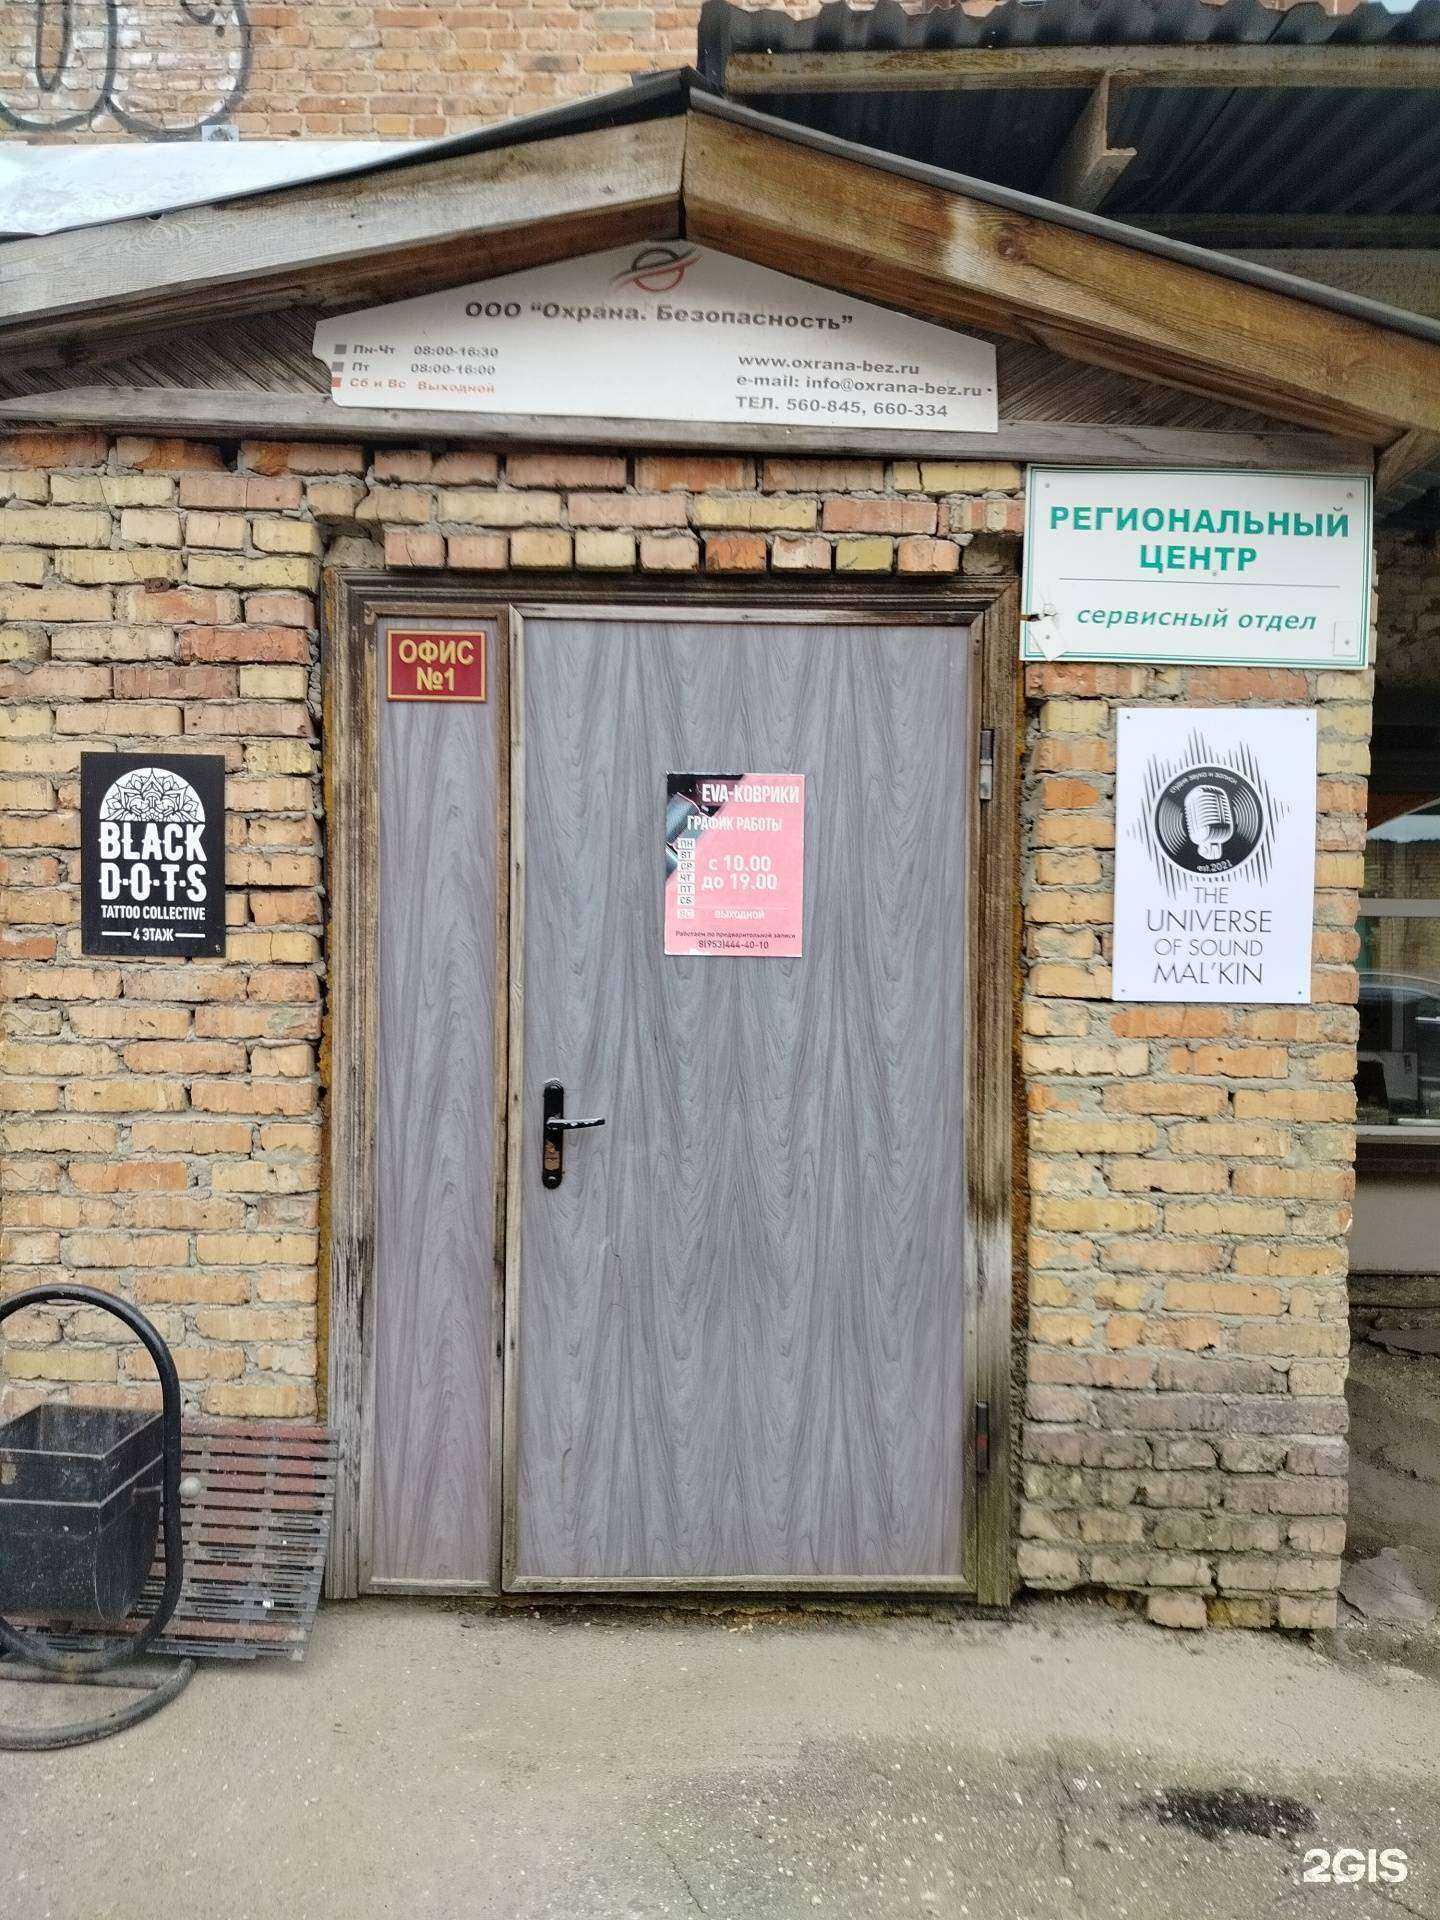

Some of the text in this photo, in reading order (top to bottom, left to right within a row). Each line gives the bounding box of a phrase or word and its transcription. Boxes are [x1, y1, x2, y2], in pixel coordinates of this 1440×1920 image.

[465, 302, 522, 317] ООО
[353, 344, 499, 357] Пн-Чт 08:00-16:30
[352, 362, 496, 375] Пт 08:00-16:00
[738, 355, 920, 375] www.oxrana-bez.ru
[350, 377, 368, 387] Сб
[417, 380, 496, 394] Выходной
[736, 374, 983, 397] e-mail: info@oxrana-bez.ru
[736, 396, 948, 417] ТЕЛ. 560-845, 660-334
[1050, 505, 1350, 538] РЕГИОНАЛЬНЫЙ
[1140, 544, 1258, 574] ЦЕНТР
[1077, 607, 1316, 632] сервисный отдел
[399, 639, 475, 665] ОФИС
[416, 666, 455, 691] №1
[701, 783, 800, 804] EVA-КОВРИКИ
[687, 815, 782, 832] ГРАФИК РАБОТЫ
[99, 822, 207, 861] BLACK
[723, 854, 772, 872] 10.00
[729, 873, 778, 890] 19.00
[1193, 886, 1229, 904] THE
[101, 905, 205, 921] TATTOO COLLECTIVE
[1146, 909, 1272, 933] UNIVERSE
[133, 928, 175, 942] 4 ЭТАЖ
[1154, 938, 1263, 957] OF SOUND
